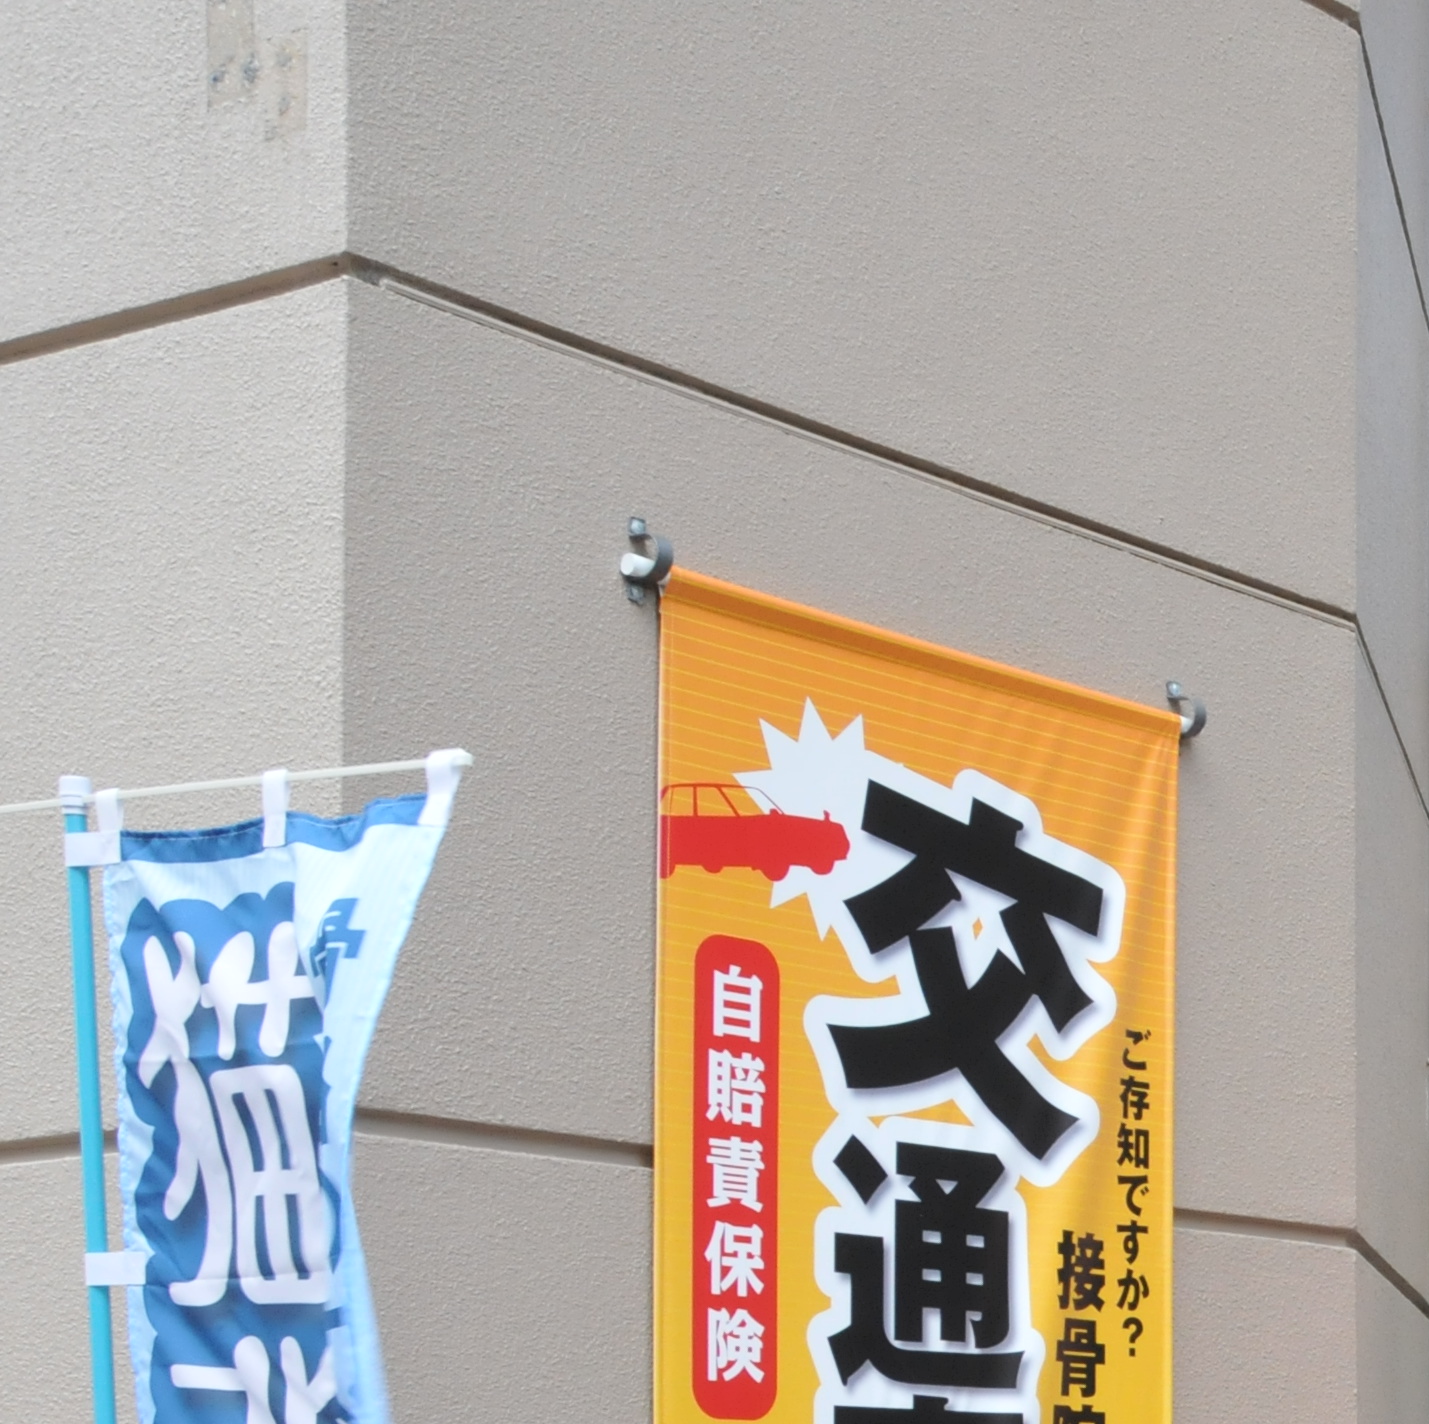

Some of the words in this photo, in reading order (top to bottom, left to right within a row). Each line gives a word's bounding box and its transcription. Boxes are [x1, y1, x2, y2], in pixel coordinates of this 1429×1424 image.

[704, 964, 767, 1386] 自賠責保険
